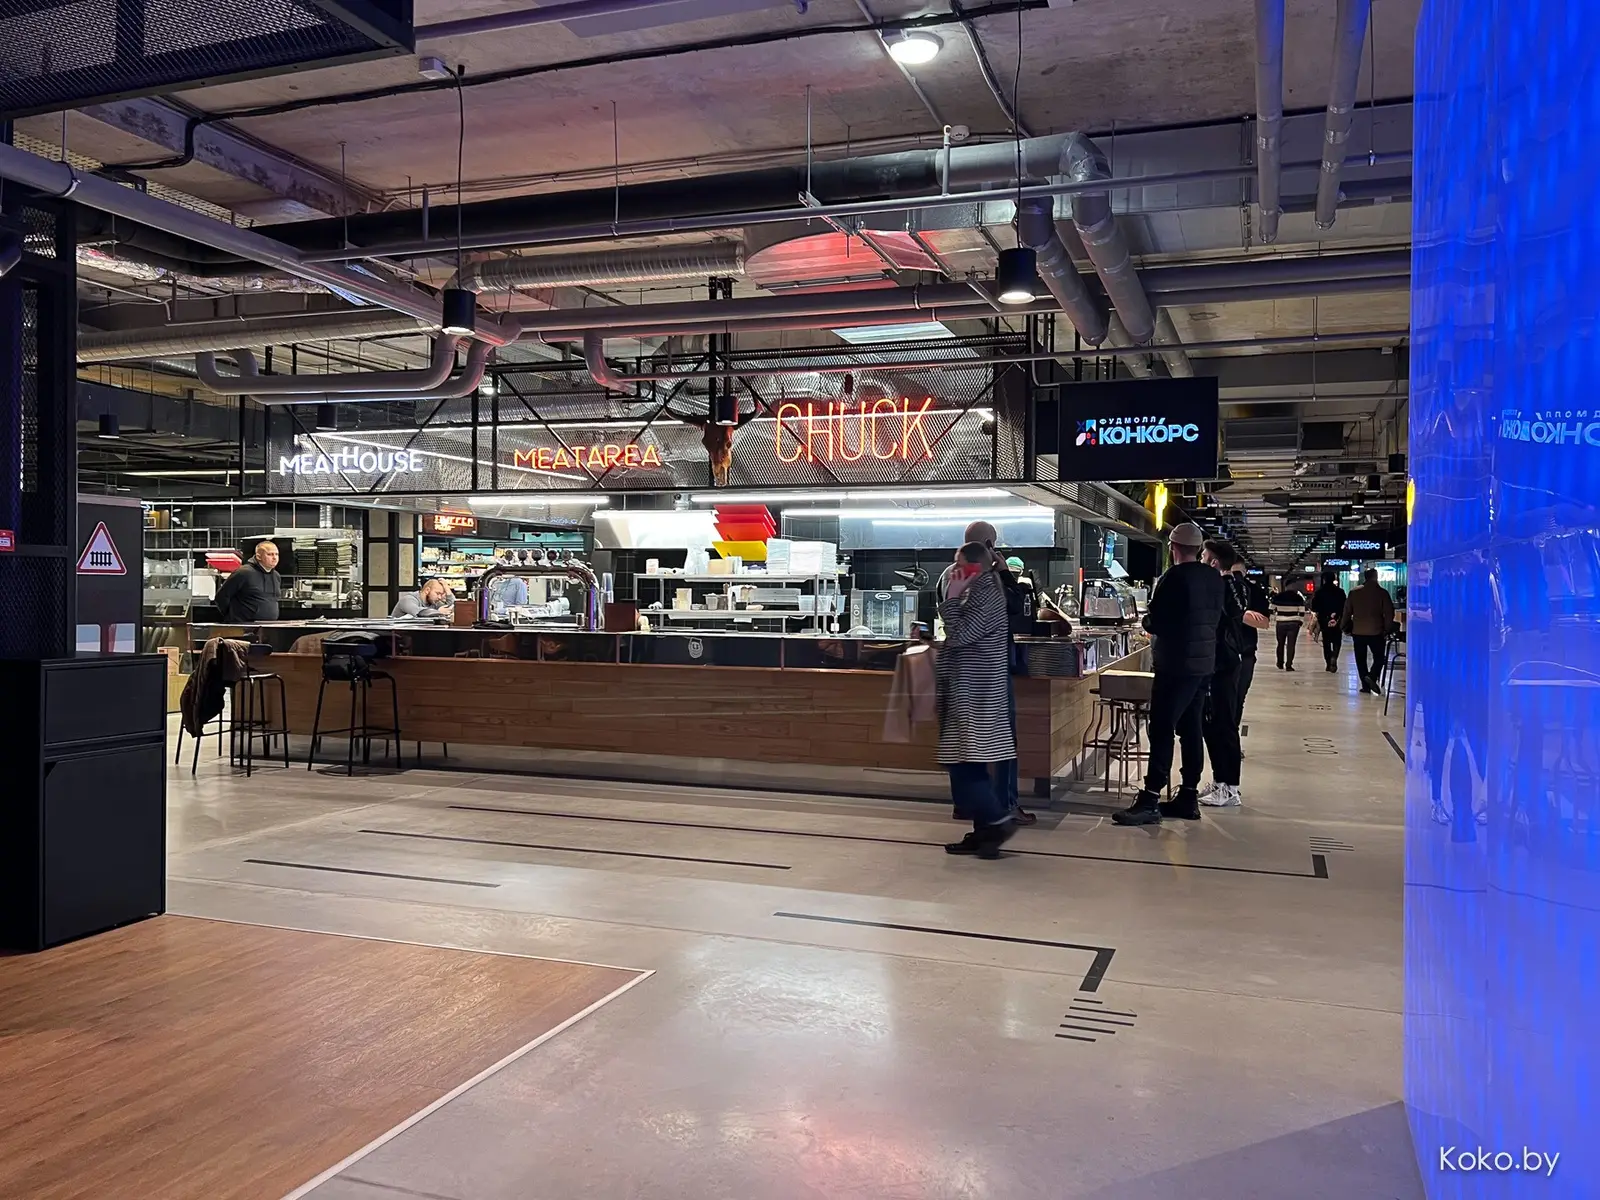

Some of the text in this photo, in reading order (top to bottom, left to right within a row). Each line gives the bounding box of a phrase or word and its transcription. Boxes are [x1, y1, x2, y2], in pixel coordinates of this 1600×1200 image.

[776, 397, 934, 463] CHUCK
[1099, 416, 1157, 425] ФУДМОЛЛ
[279, 445, 424, 477] MEATHOUSE
[513, 444, 662, 470] MEATAREA
